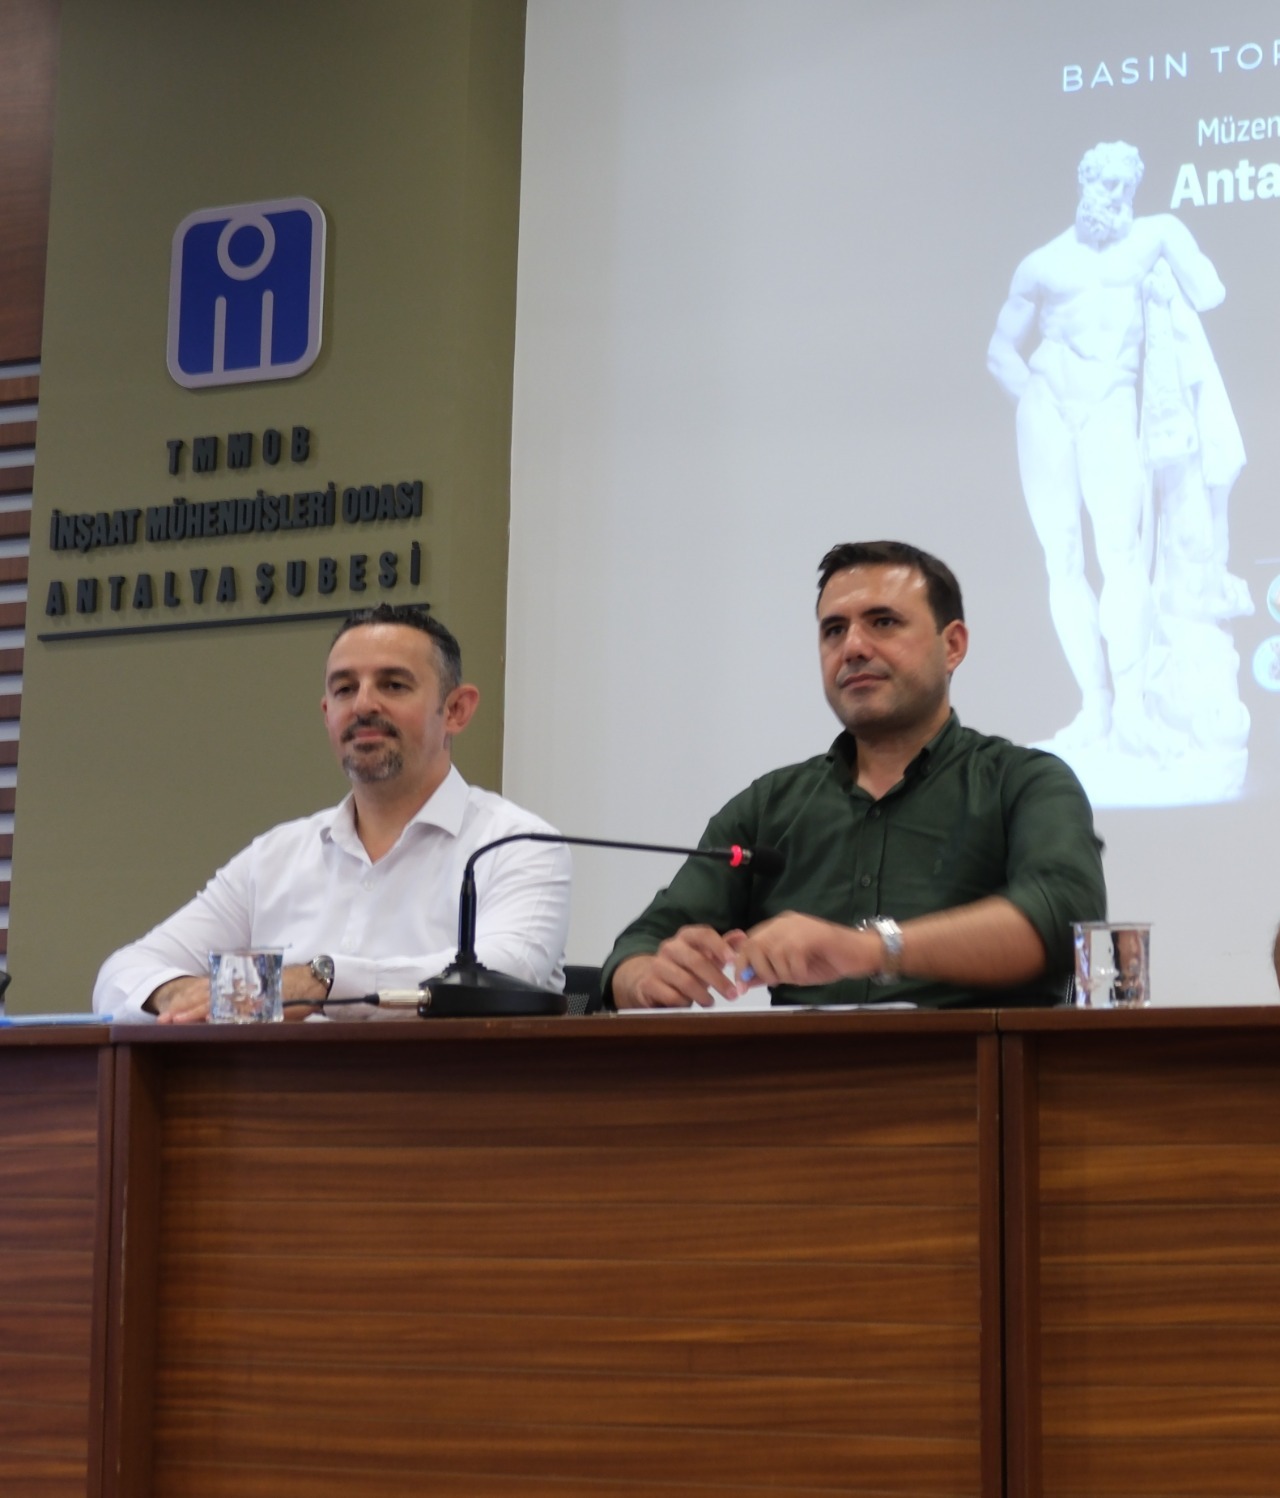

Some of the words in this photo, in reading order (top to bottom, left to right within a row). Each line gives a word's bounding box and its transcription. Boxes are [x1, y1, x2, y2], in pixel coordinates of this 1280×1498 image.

[1062, 51, 1188, 92] BASIN
[167, 426, 311, 476] TMMOB
[50, 508, 141, 552] İNŞAAT
[145, 481, 336, 543] MÜHENDİSLERİ
[342, 480, 424, 523] ODASI
[45, 564, 237, 617] ANTALYA
[255, 541, 422, 605] ŞUBESİ
